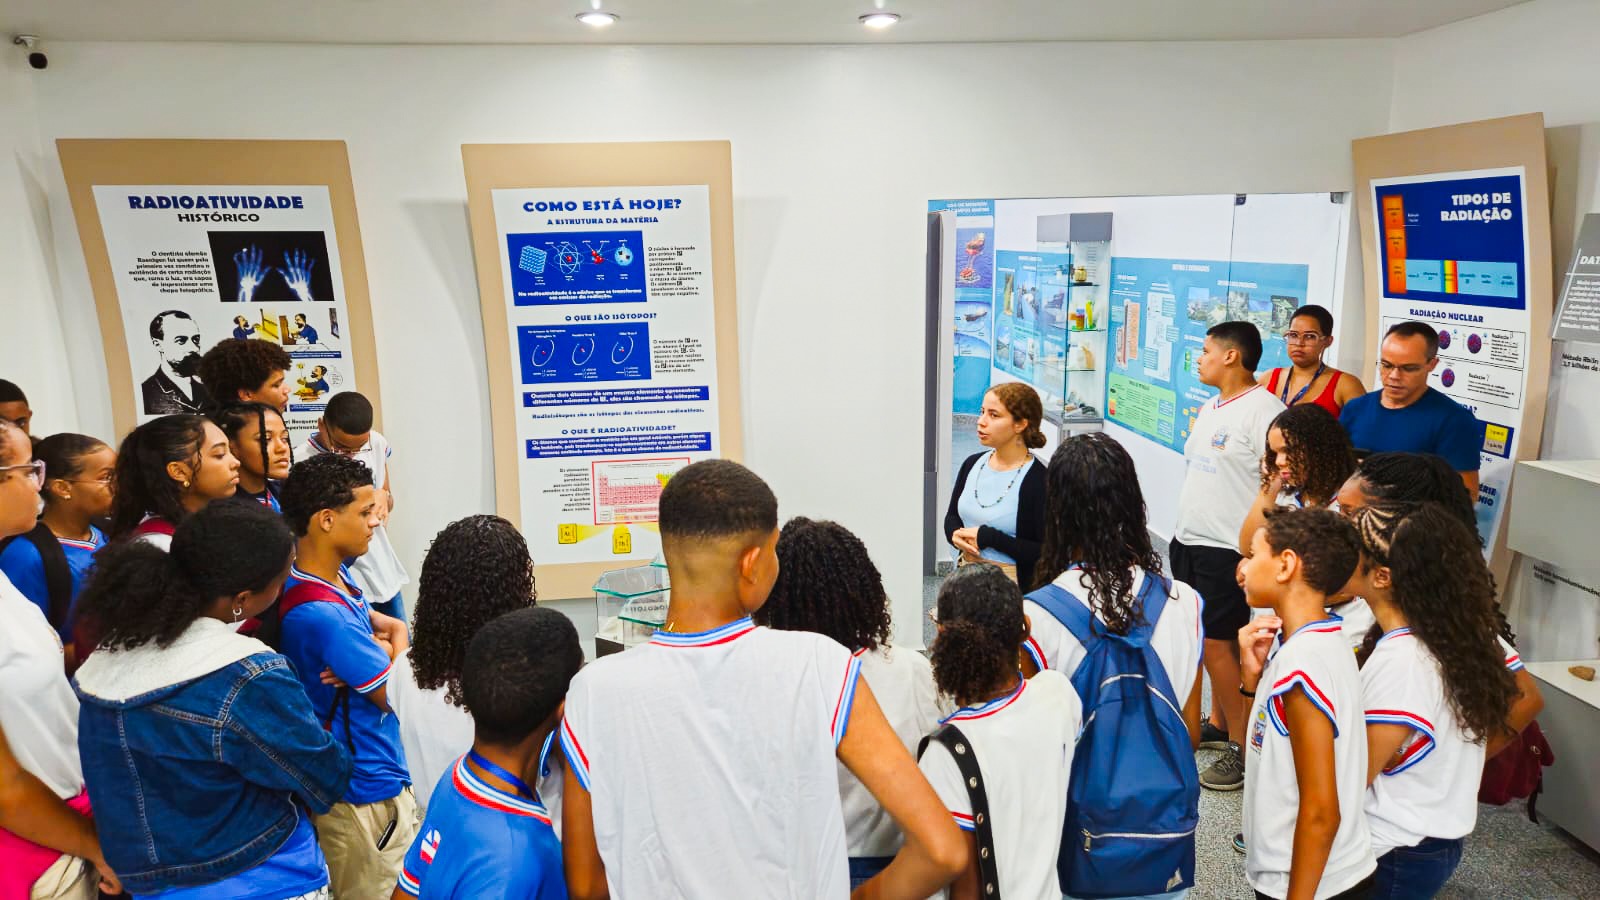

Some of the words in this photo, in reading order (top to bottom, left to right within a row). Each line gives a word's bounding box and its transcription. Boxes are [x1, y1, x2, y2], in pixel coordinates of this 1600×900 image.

[127, 195, 304, 209] RADIOATIVIDADE
[522, 201, 578, 212] COMO
[583, 197, 625, 211] ESTÁ
[628, 198, 683, 210] HOJE?
[1451, 192, 1489, 206] TIPOS
[1491, 191, 1512, 204] DE
[177, 211, 260, 222] HISTÓRICO
[620, 216, 659, 224] MATÉRIA
[1440, 207, 1513, 223] RADIAÇÃO
[573, 314, 592, 322] QUE
[612, 312, 657, 320] ISÓTOPOS?
[1409, 308, 1447, 319] RADIAÇÃO
[1448, 312, 1484, 323] NUCLEAR
[590, 426, 597, 434] É
[598, 425, 676, 434] RADIOATIVIDADE?
[1478, 483, 1497, 496] ÉRIE
